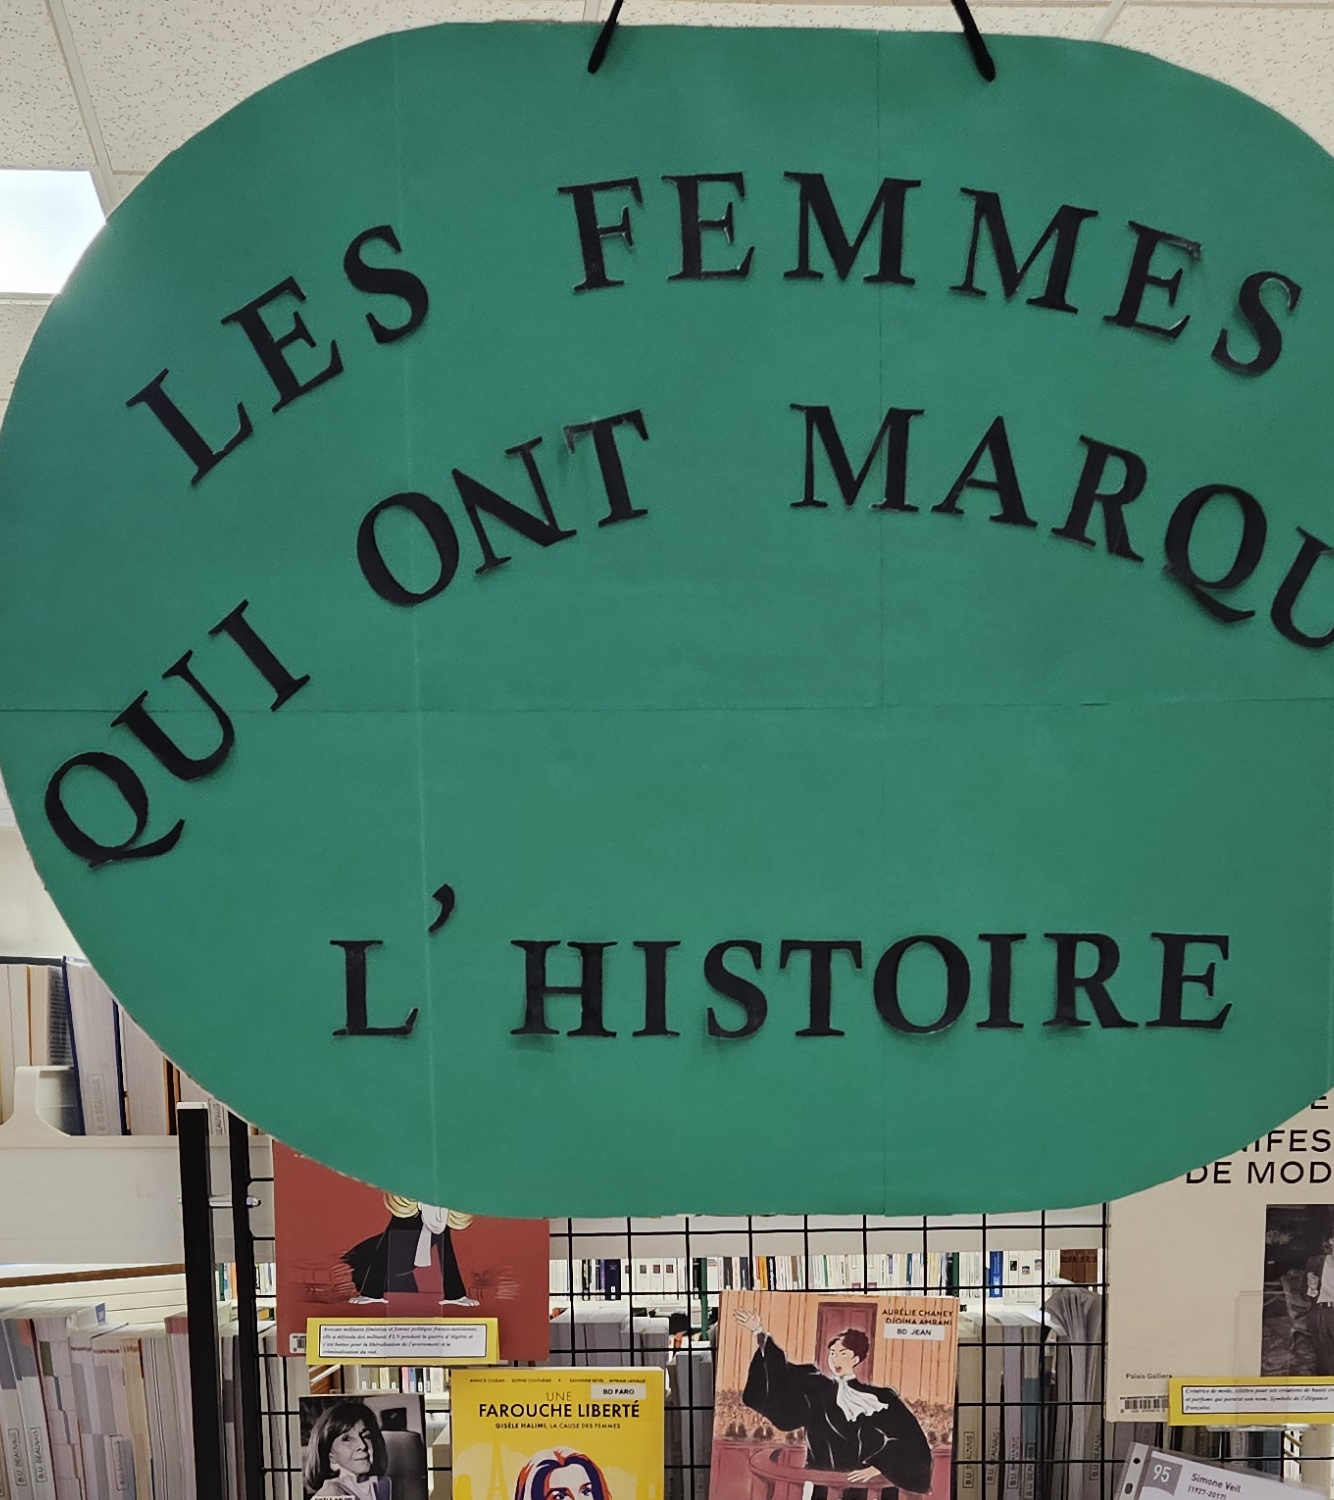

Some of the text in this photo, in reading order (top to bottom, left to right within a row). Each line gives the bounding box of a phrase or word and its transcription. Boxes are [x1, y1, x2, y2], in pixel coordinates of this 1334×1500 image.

[127, 171, 1304, 487] LES FEMMES
[43, 600, 311, 868] QUI
[355, 408, 650, 608] ONT
[1186, 1162, 1232, 1183] DE
[882, 1308, 954, 1318] AURÉLIE CHANEY
[911, 1328, 932, 1336] JEAN
[546, 1391, 572, 1401] UNE
[479, 1400, 639, 1418] FAROUCHE LIBERTÉ
[1152, 1464, 1171, 1483] 95
[1191, 1473, 1241, 1493] Simone Veil
